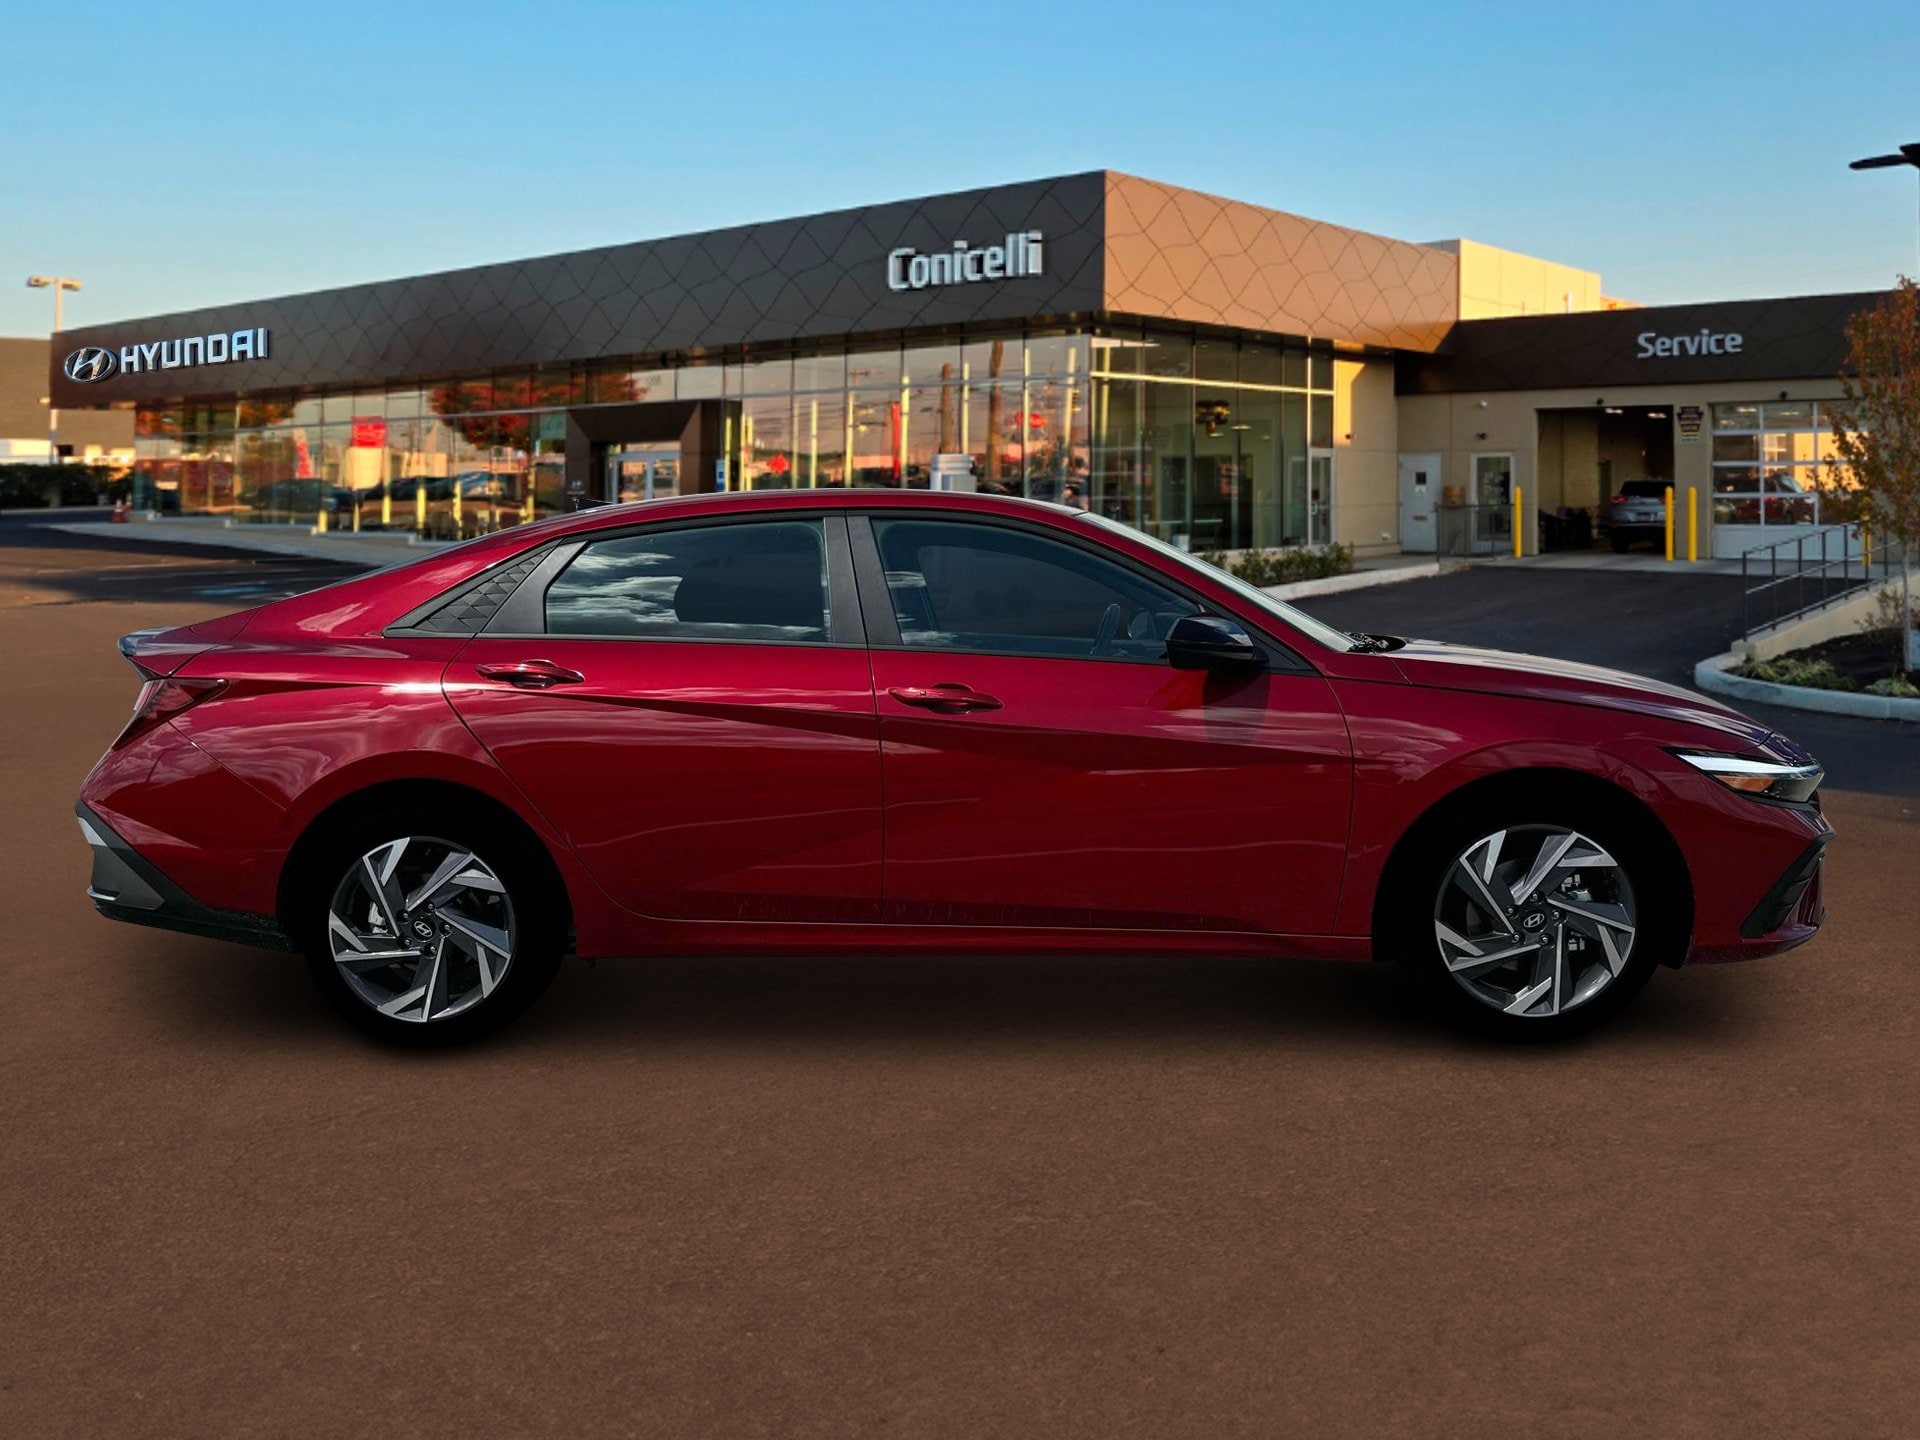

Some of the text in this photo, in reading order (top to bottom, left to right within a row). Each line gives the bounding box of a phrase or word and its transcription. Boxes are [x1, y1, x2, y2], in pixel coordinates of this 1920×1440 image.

[888, 231, 1043, 290] Conicelli
[120, 327, 268, 374] HYUNDAI
[1637, 328, 1743, 359] Service
